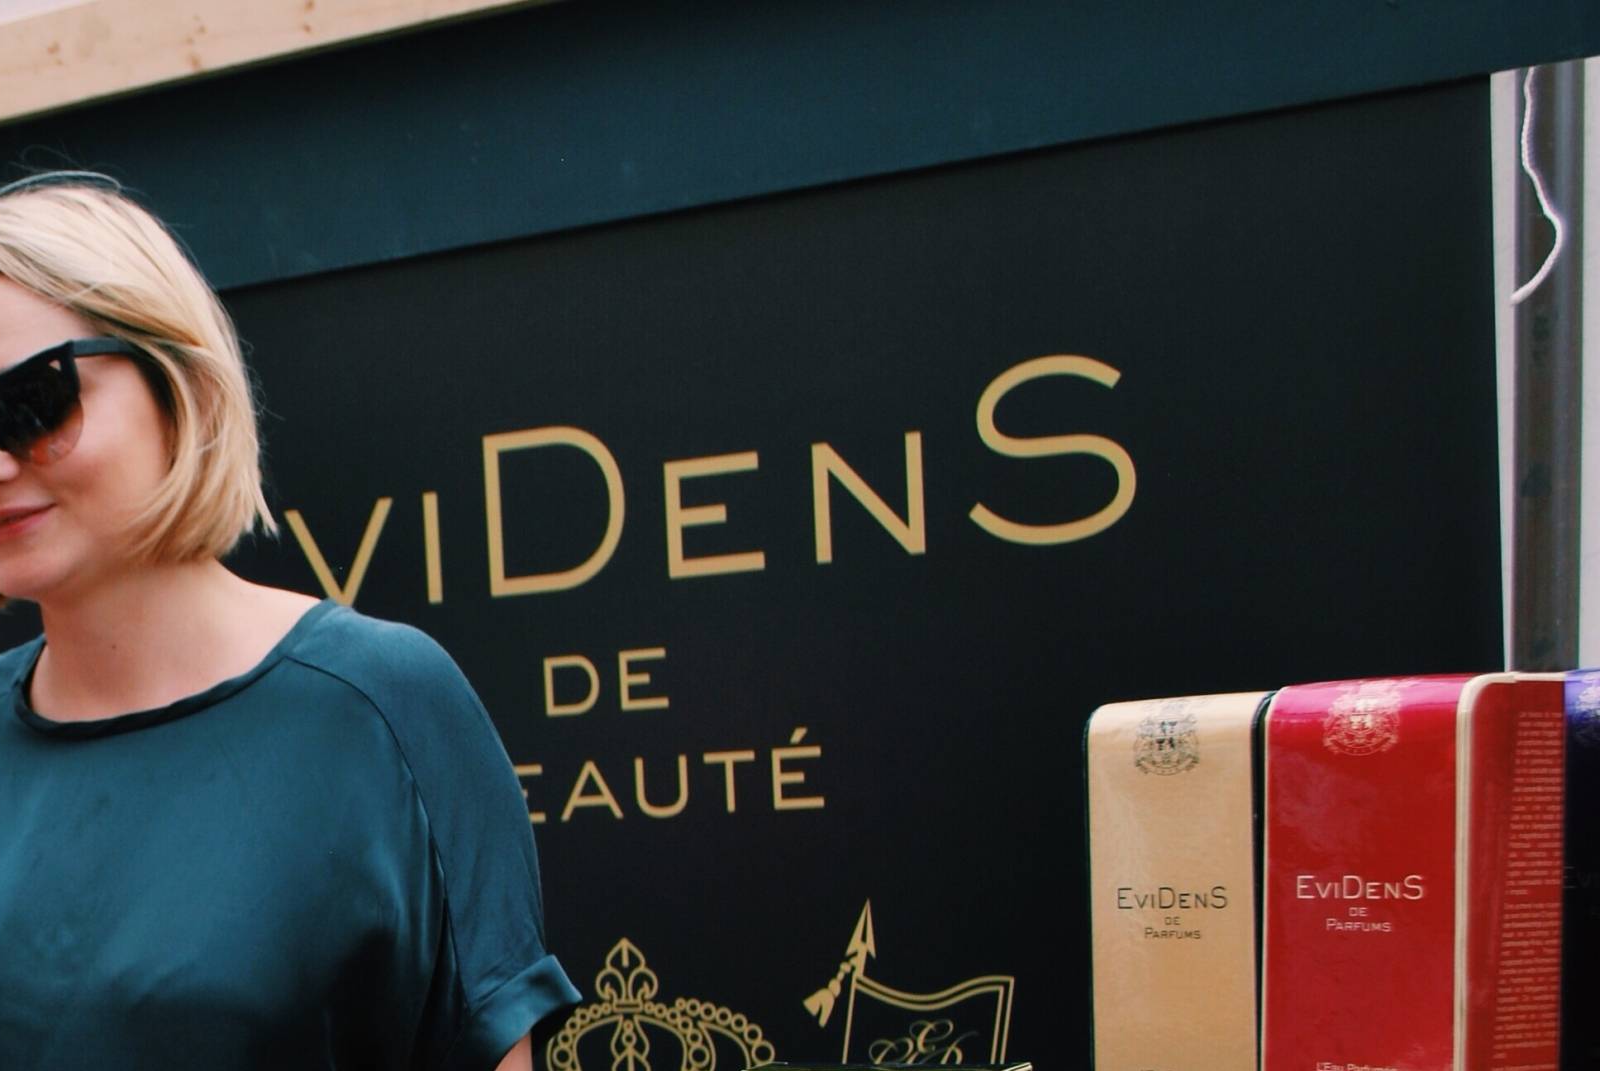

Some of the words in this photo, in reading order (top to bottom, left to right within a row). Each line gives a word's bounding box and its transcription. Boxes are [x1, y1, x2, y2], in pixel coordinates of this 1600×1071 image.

[285, 354, 1137, 605] VIDENS
[543, 647, 669, 717] DE
[513, 727, 825, 822] AUTÉ
[1164, 916, 1181, 926] DE
[1349, 906, 1368, 917] DE
